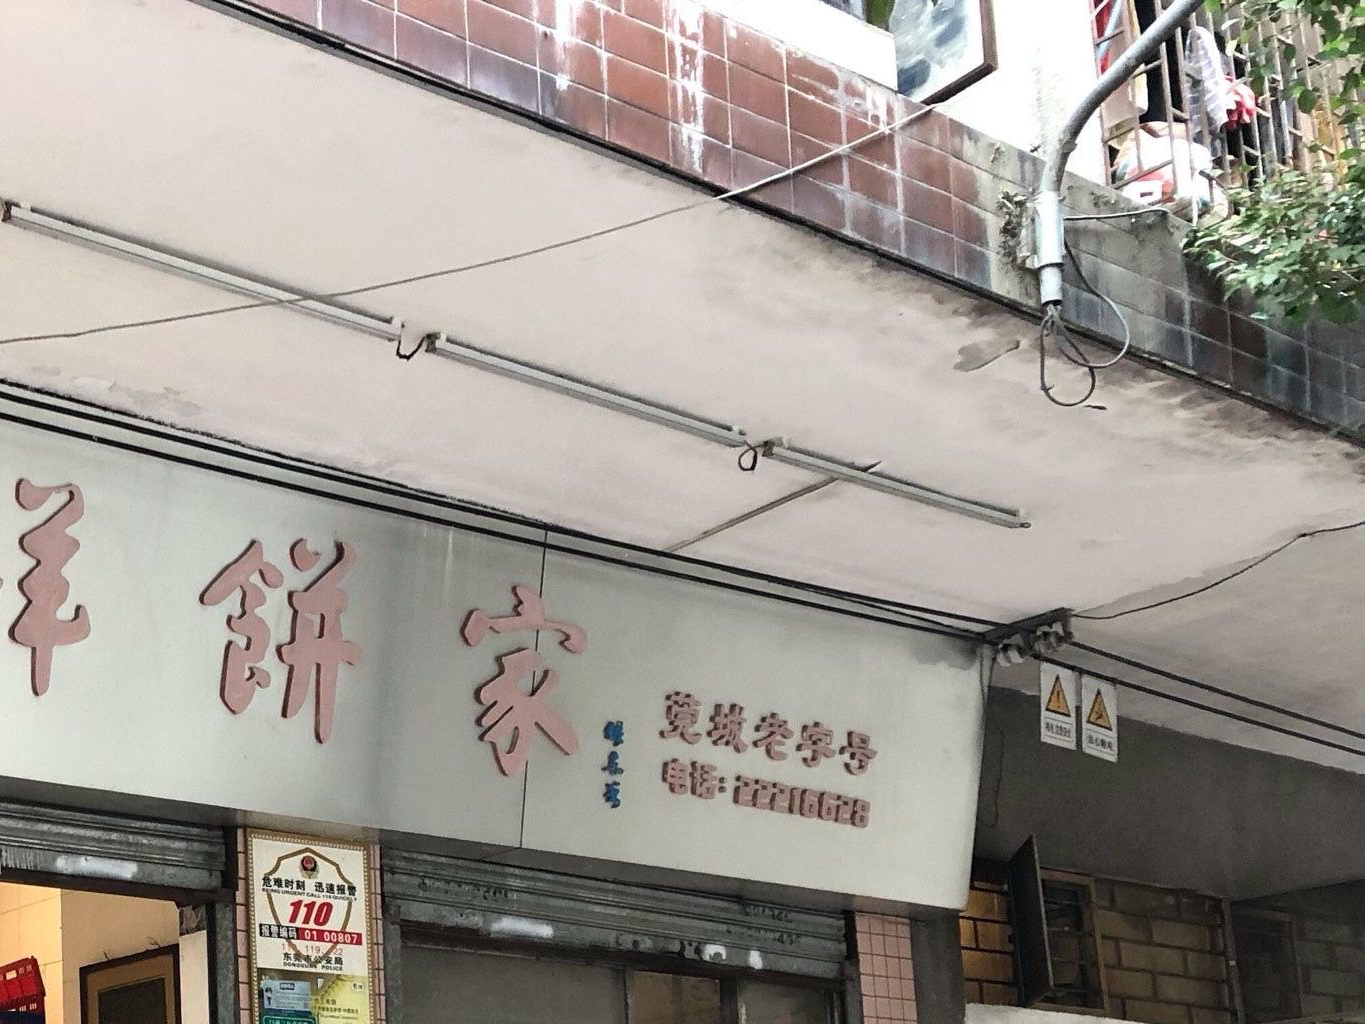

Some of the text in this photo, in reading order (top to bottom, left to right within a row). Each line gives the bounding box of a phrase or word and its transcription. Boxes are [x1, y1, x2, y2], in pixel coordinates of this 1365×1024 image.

[658, 691, 879, 776] 莞城老字号
[262, 876, 357, 897] 危难时刻 迅速报警
[289, 900, 333, 926] 110
[261, 924, 358, 944] 报警编码 01 00807
[283, 952, 343, 967] 东莞市公安局
[321, 964, 343, 972] POLICE
